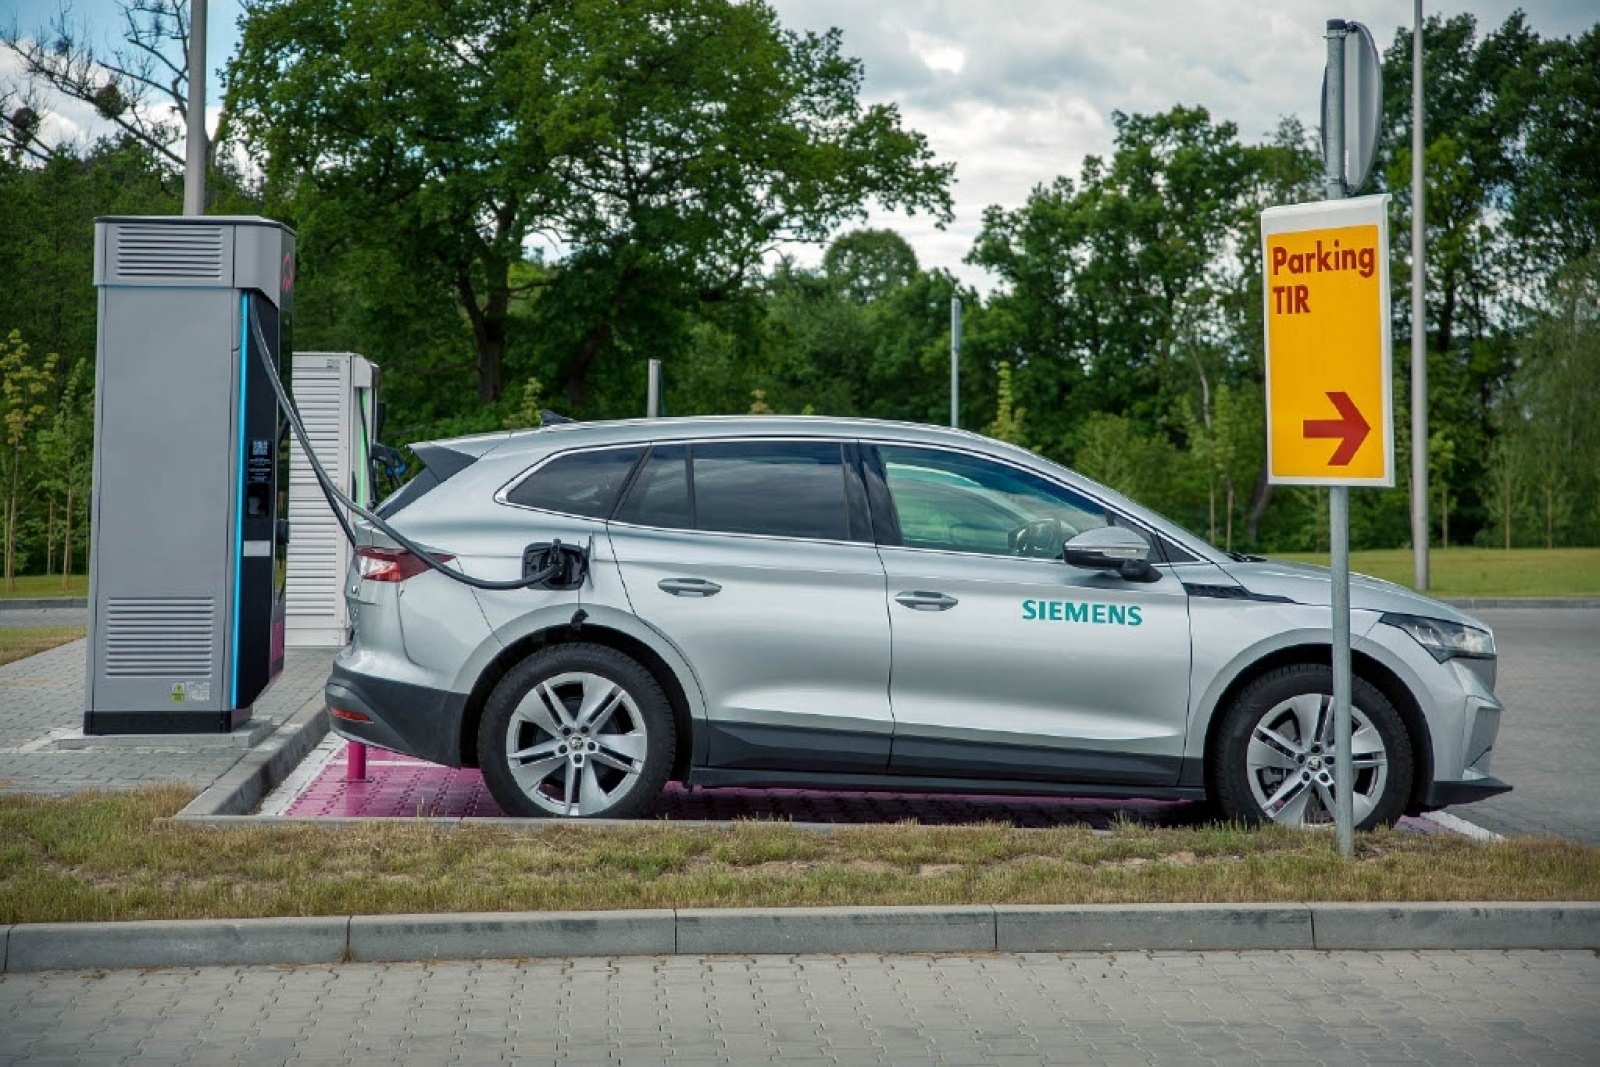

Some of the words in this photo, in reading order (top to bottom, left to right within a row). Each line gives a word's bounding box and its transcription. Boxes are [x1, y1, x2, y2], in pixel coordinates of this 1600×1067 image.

[1272, 239, 1375, 278] Parking
[1272, 284, 1311, 315] TIR
[1021, 599, 1143, 626] SIEMENS
